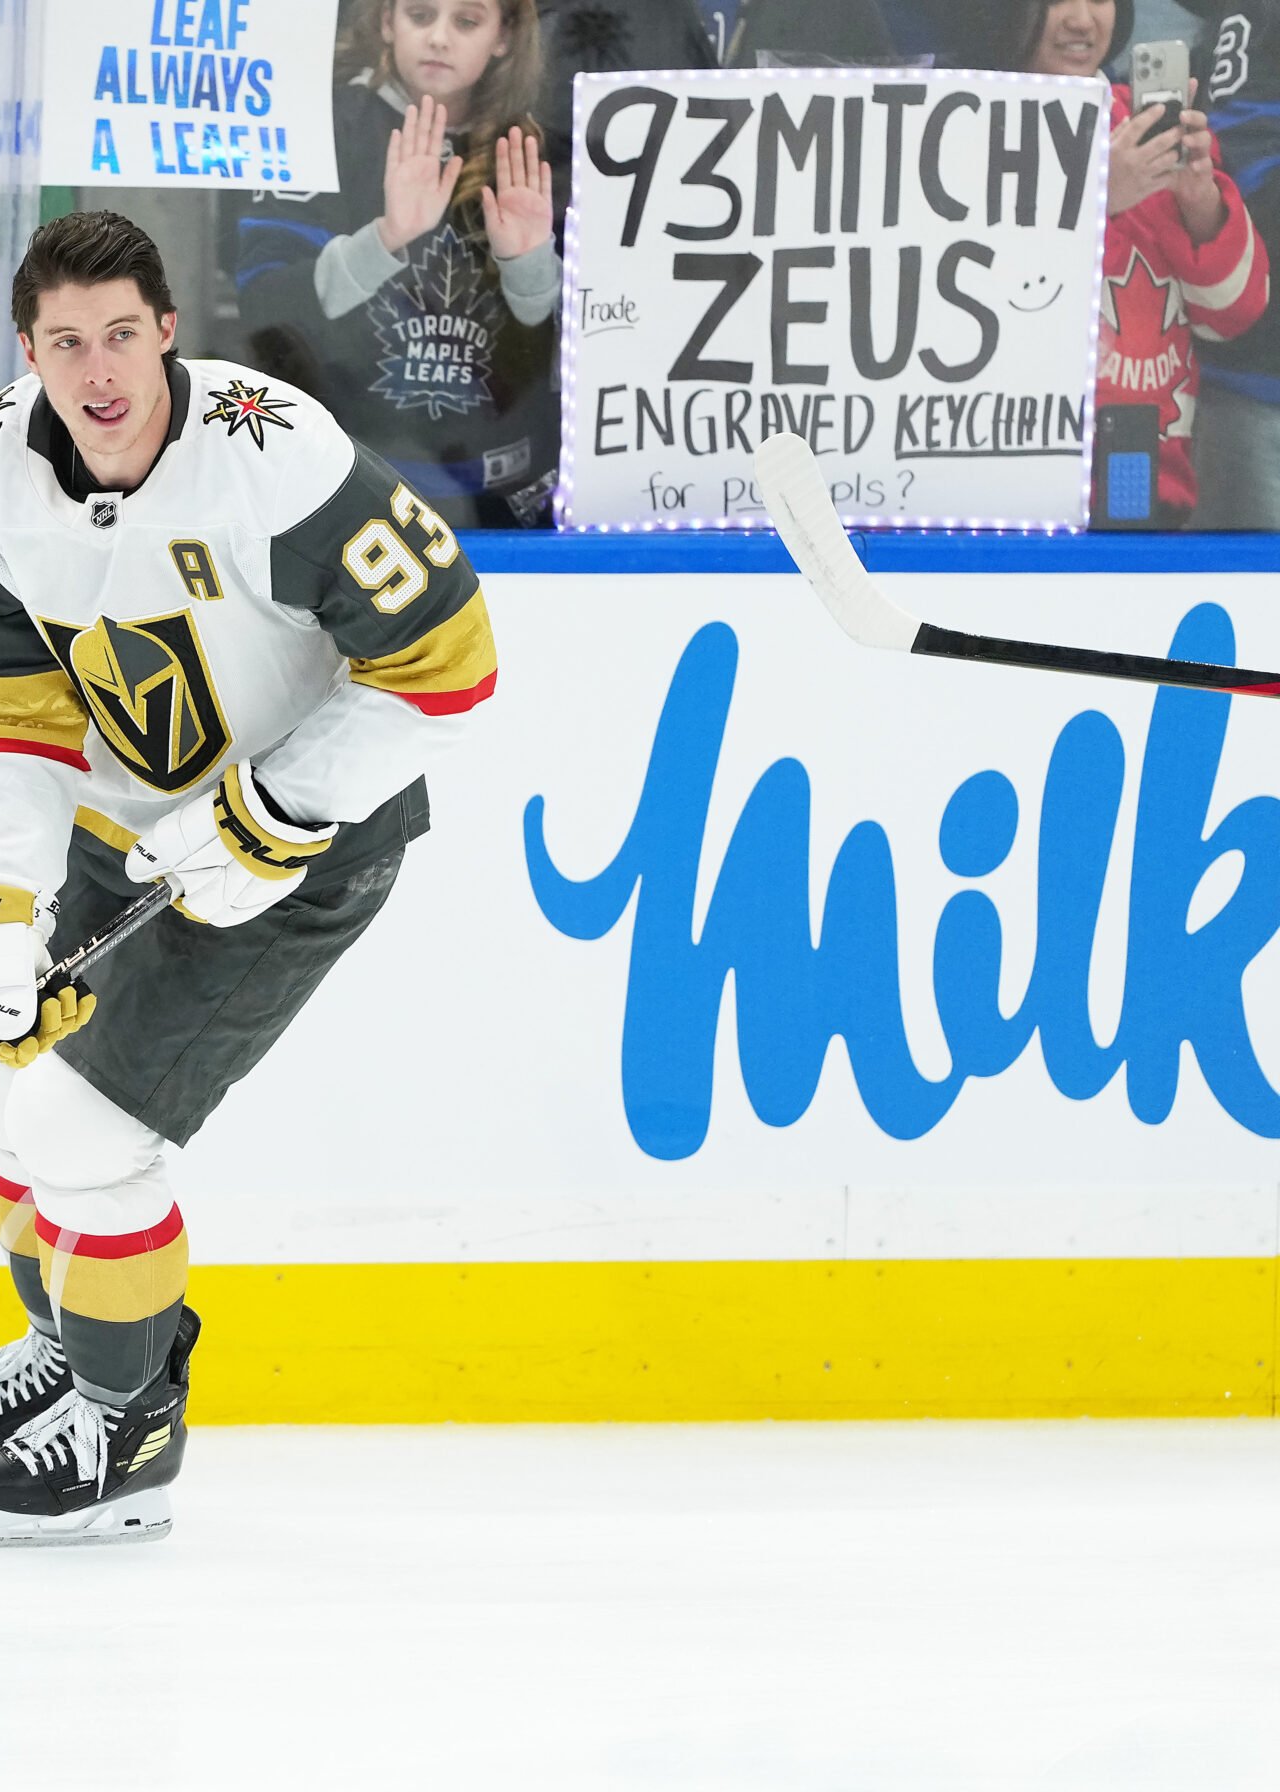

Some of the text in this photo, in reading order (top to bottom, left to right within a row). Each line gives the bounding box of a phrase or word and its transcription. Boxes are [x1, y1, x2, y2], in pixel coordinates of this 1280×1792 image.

[150, 0, 250, 50] LEAF
[94, 45, 273, 117] ALWAYS
[91, 118, 121, 175] A
[392, 314, 488, 349] TORONTO
[578, 288, 639, 325] Trade
[668, 240, 1000, 385] ZEUS
[404, 361, 473, 385] LEAFS
[407, 341, 475, 363] MAPLE
[1099, 343, 1182, 392] ANADA
[595, 385, 1085, 456] ENGRAVED KEYCHAIN
[646, 471, 695, 512] for
[168, 539, 224, 601] A
[342, 481, 461, 615] 93
[523, 602, 1280, 1161] Milk
[144, 1397, 179, 1420] TRUE
